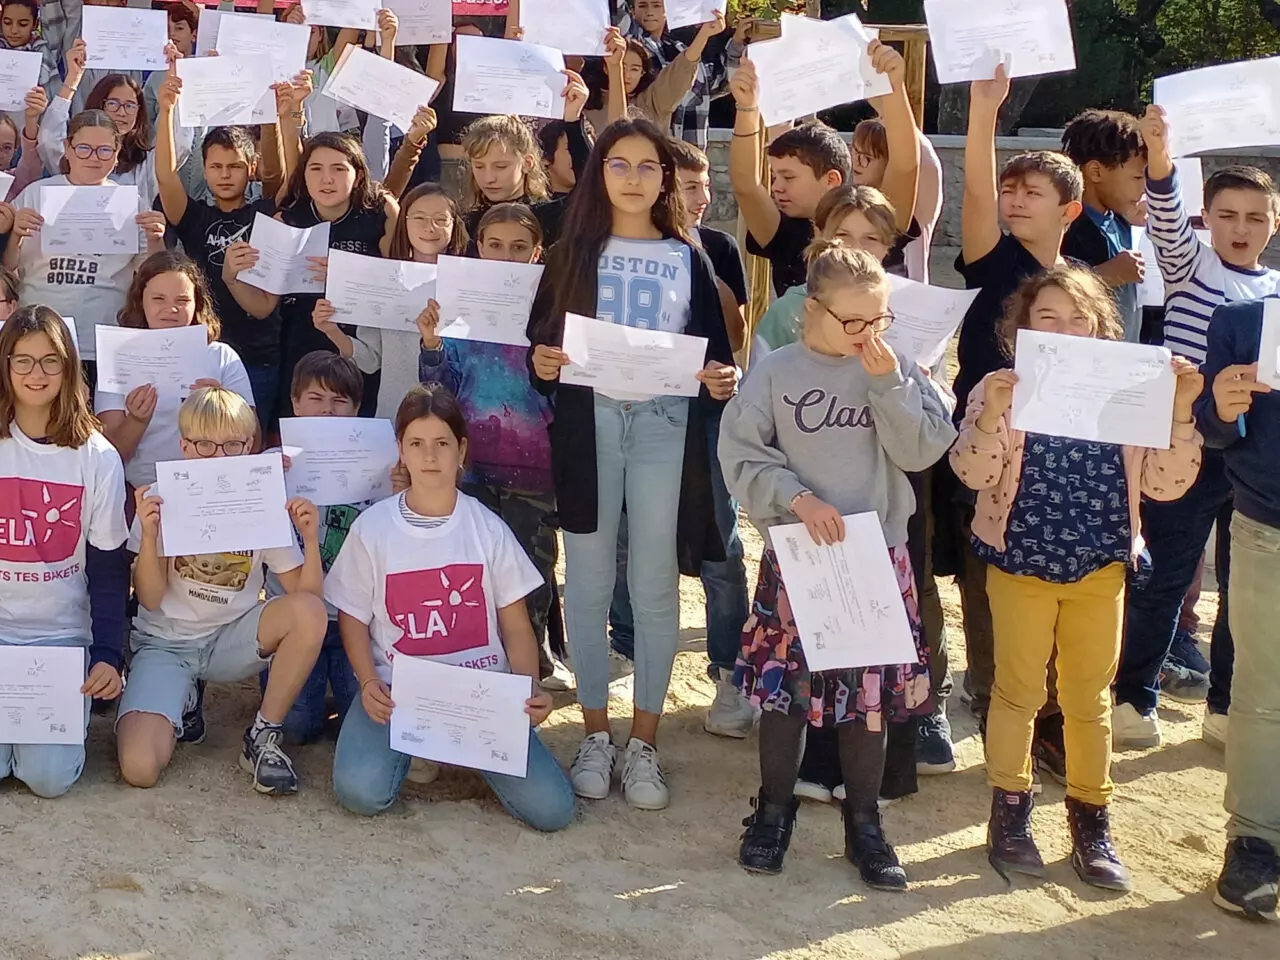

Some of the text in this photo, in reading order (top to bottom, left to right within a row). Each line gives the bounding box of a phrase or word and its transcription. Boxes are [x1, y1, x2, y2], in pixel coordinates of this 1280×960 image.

[49, 258, 99, 274] GIRLS
[598, 255, 679, 281] OSTON
[47, 271, 96, 286] SQUAD
[781, 388, 874, 434] Clas
[14, 570, 40, 583] TES
